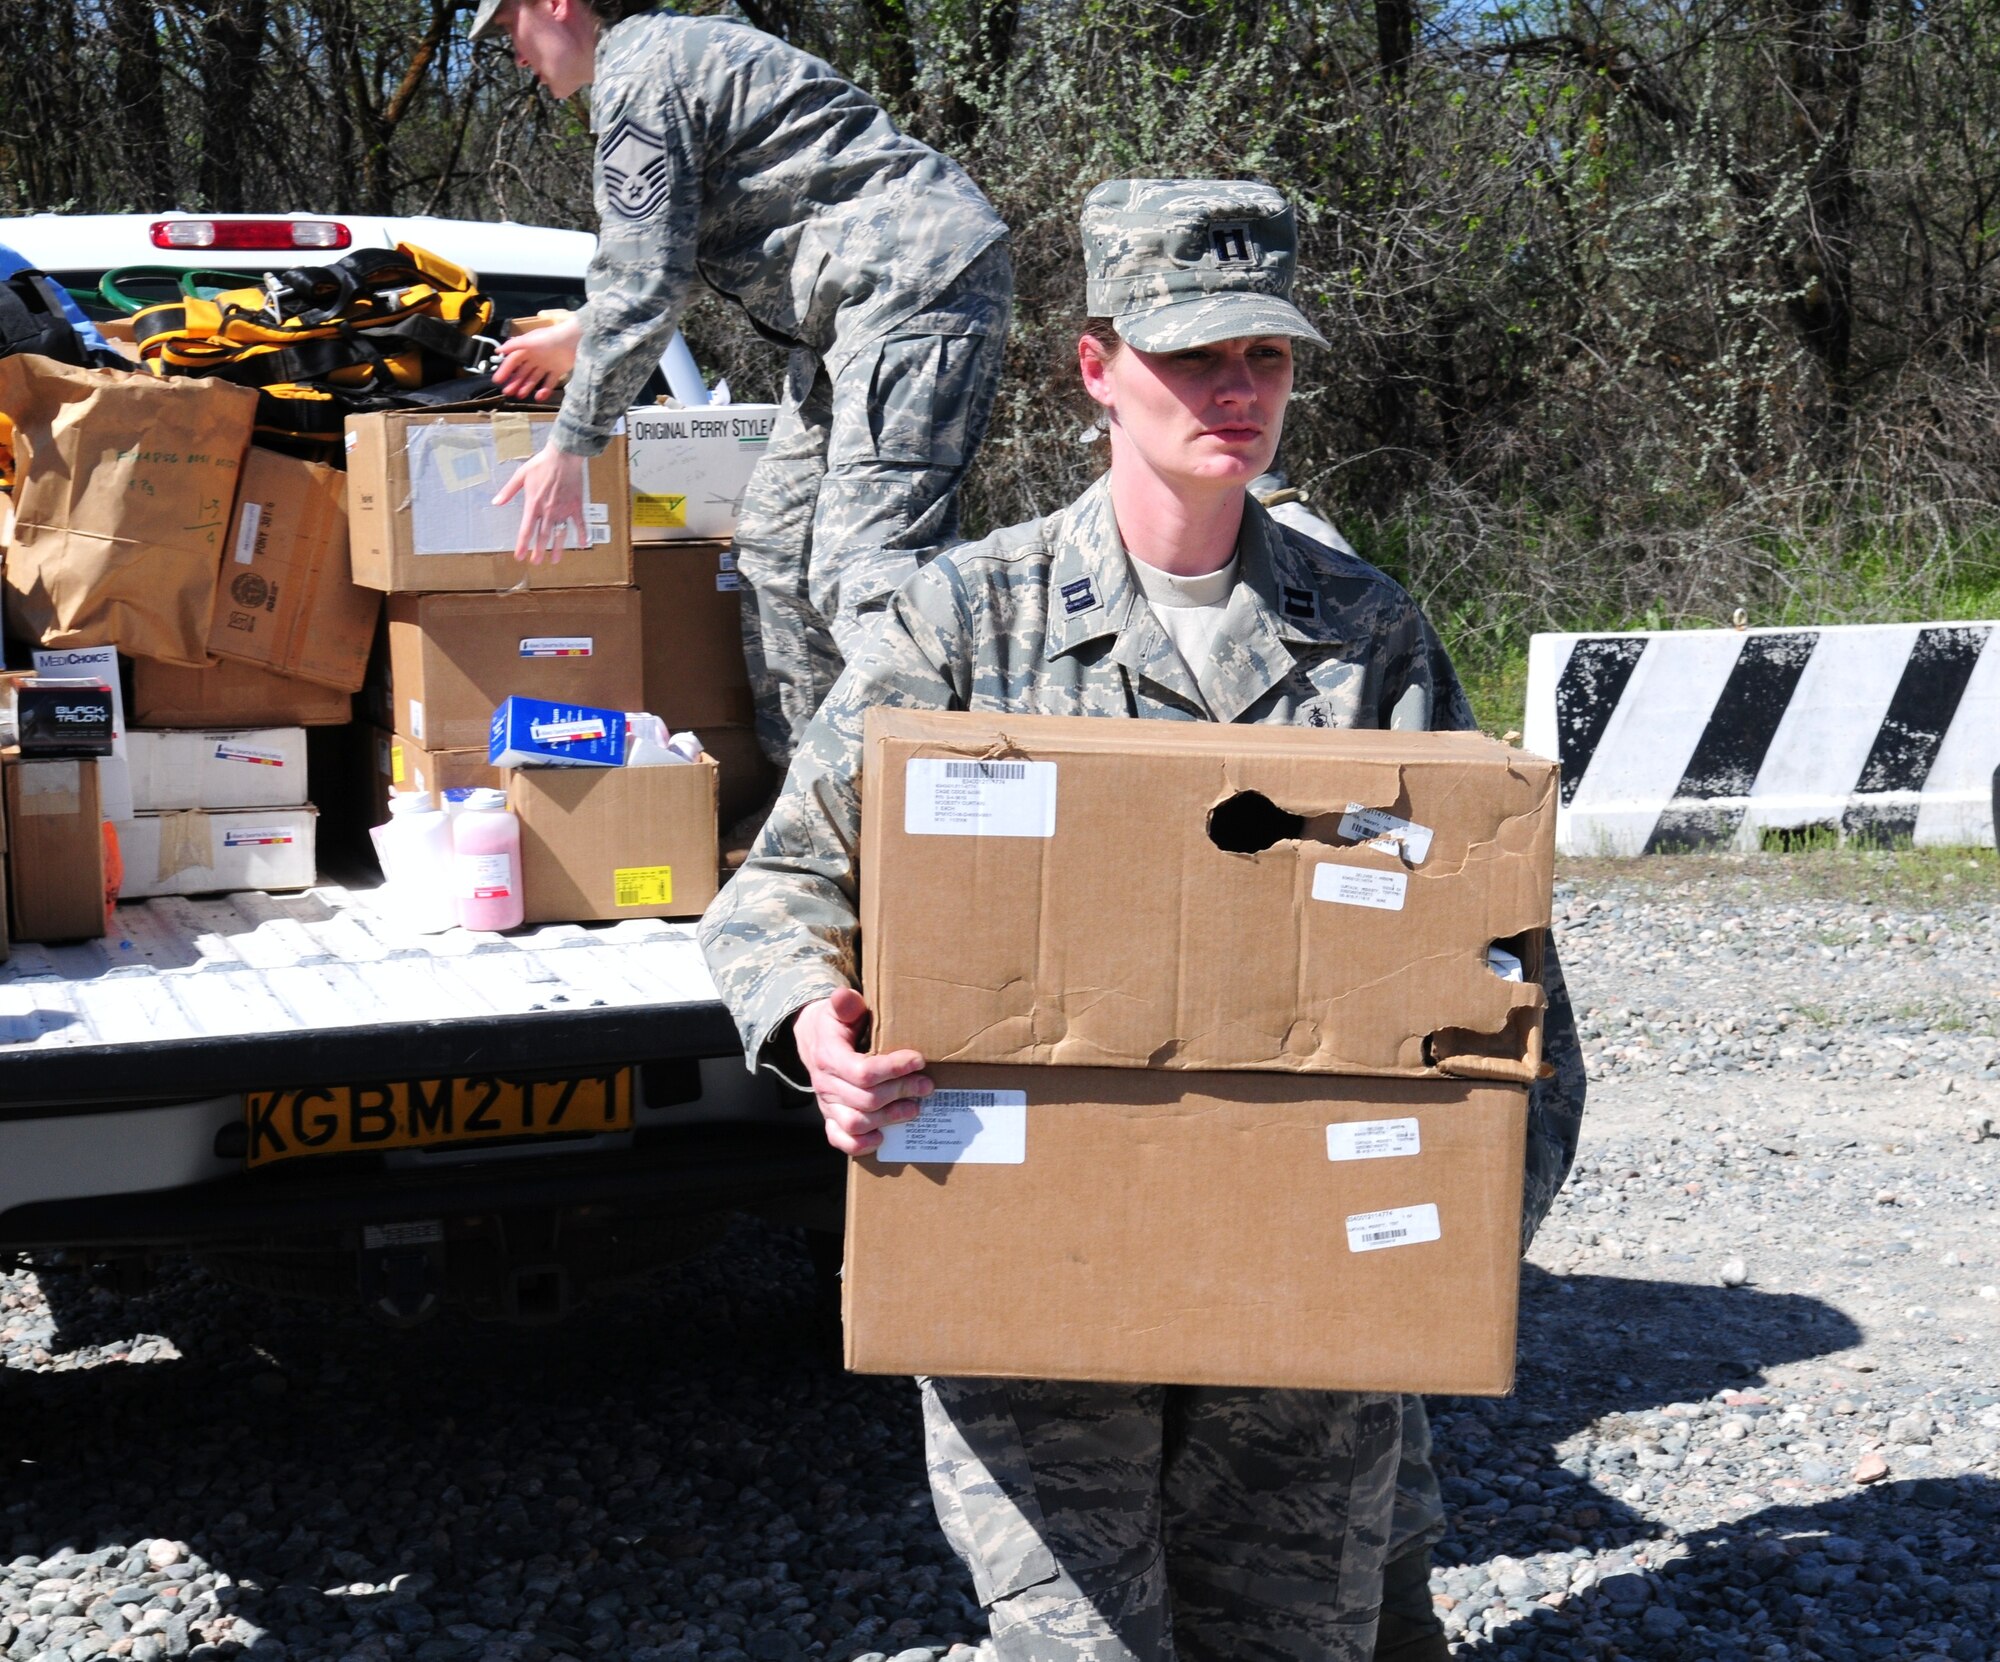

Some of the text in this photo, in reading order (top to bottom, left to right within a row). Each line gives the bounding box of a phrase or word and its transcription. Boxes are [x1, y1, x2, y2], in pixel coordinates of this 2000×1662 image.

[635, 421, 688, 441] ORIGINAL
[691, 420, 729, 439] PERRY
[732, 418, 768, 437] STYLE
[55, 705, 104, 714] BLACK
